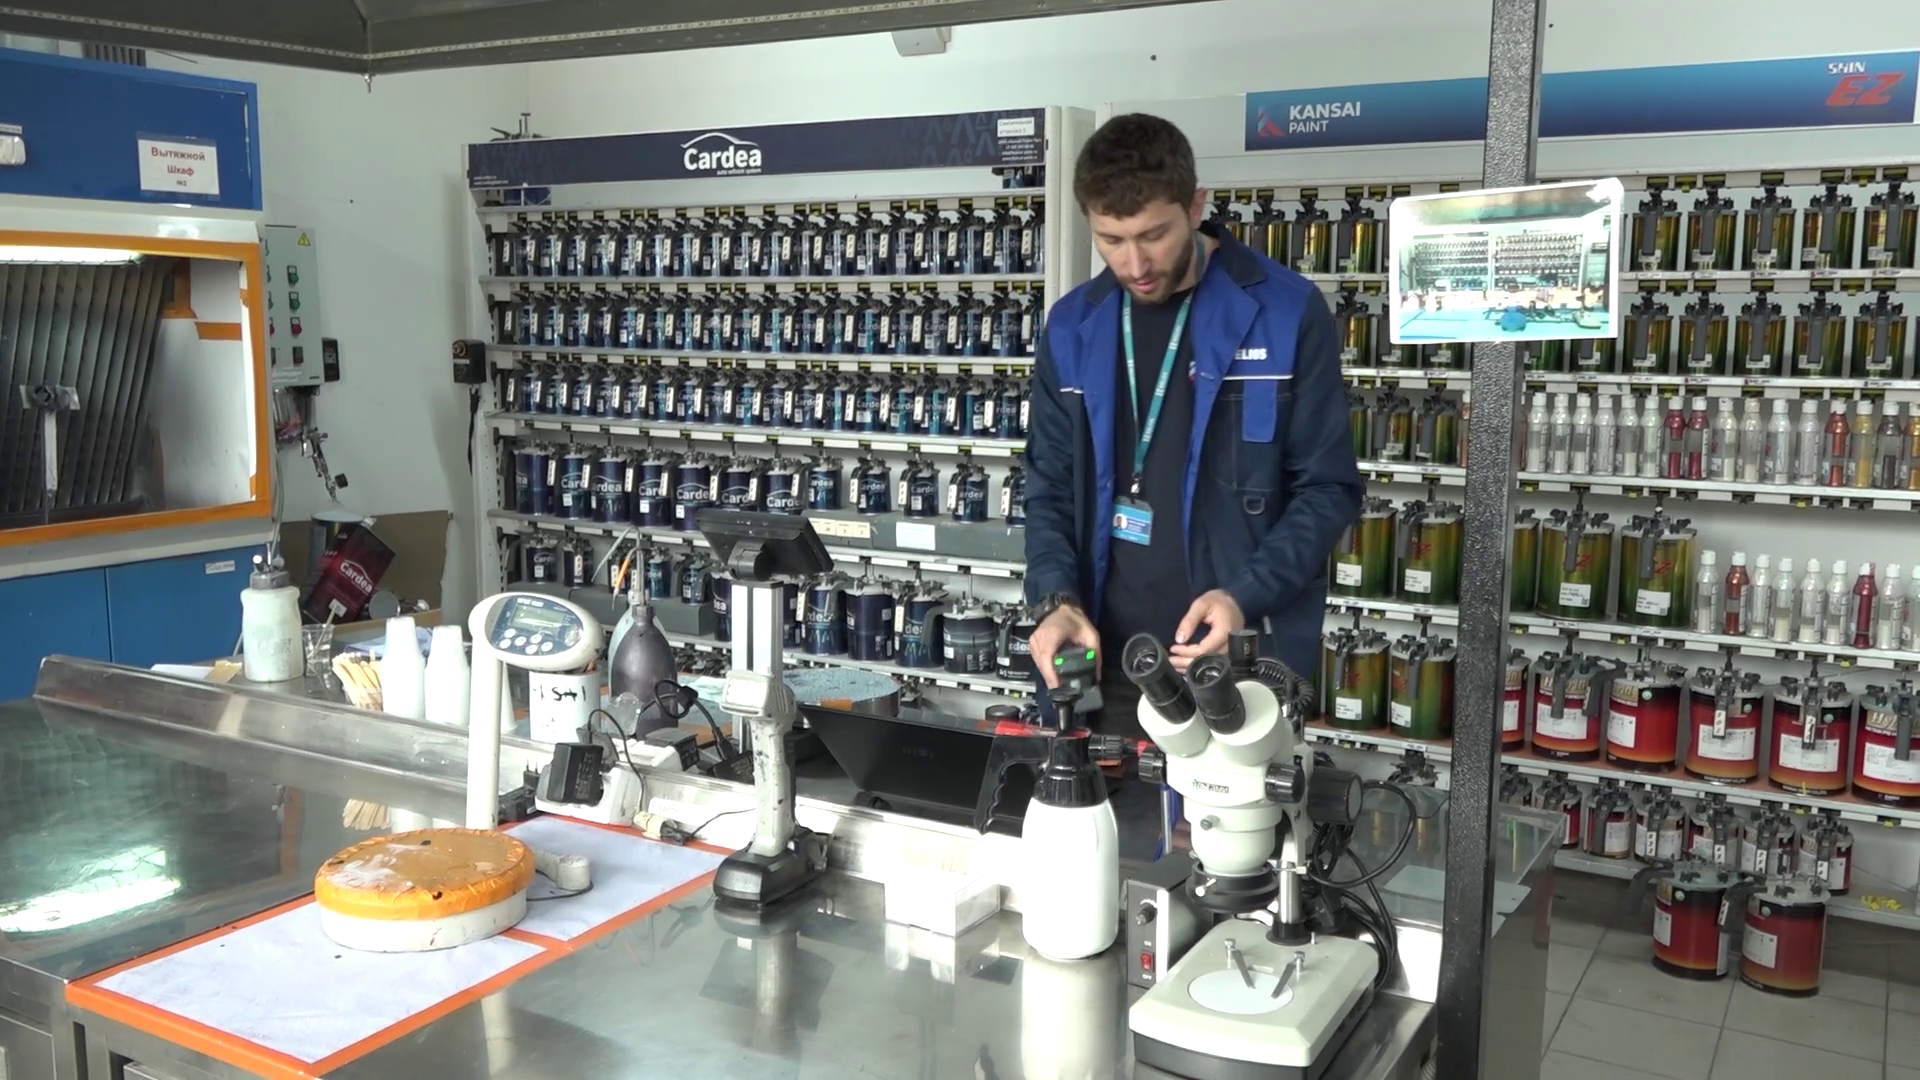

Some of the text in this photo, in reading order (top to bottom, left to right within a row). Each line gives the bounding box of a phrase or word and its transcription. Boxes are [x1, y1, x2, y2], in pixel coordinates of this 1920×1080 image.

[1828, 61, 1866, 75] SHIN
[1825, 72, 1905, 106] EZ
[1289, 101, 1361, 120] KANSAI
[1289, 120, 1329, 134] PAINT
[151, 147, 206, 162] Вытяжной
[683, 145, 762, 171] Cardea
[167, 165, 194, 177] Шкаф
[1234, 348, 1268, 361] ELIOS
[676, 488, 709, 500] Carde
[721, 492, 750, 504] Card
[340, 561, 373, 593] Cardea
